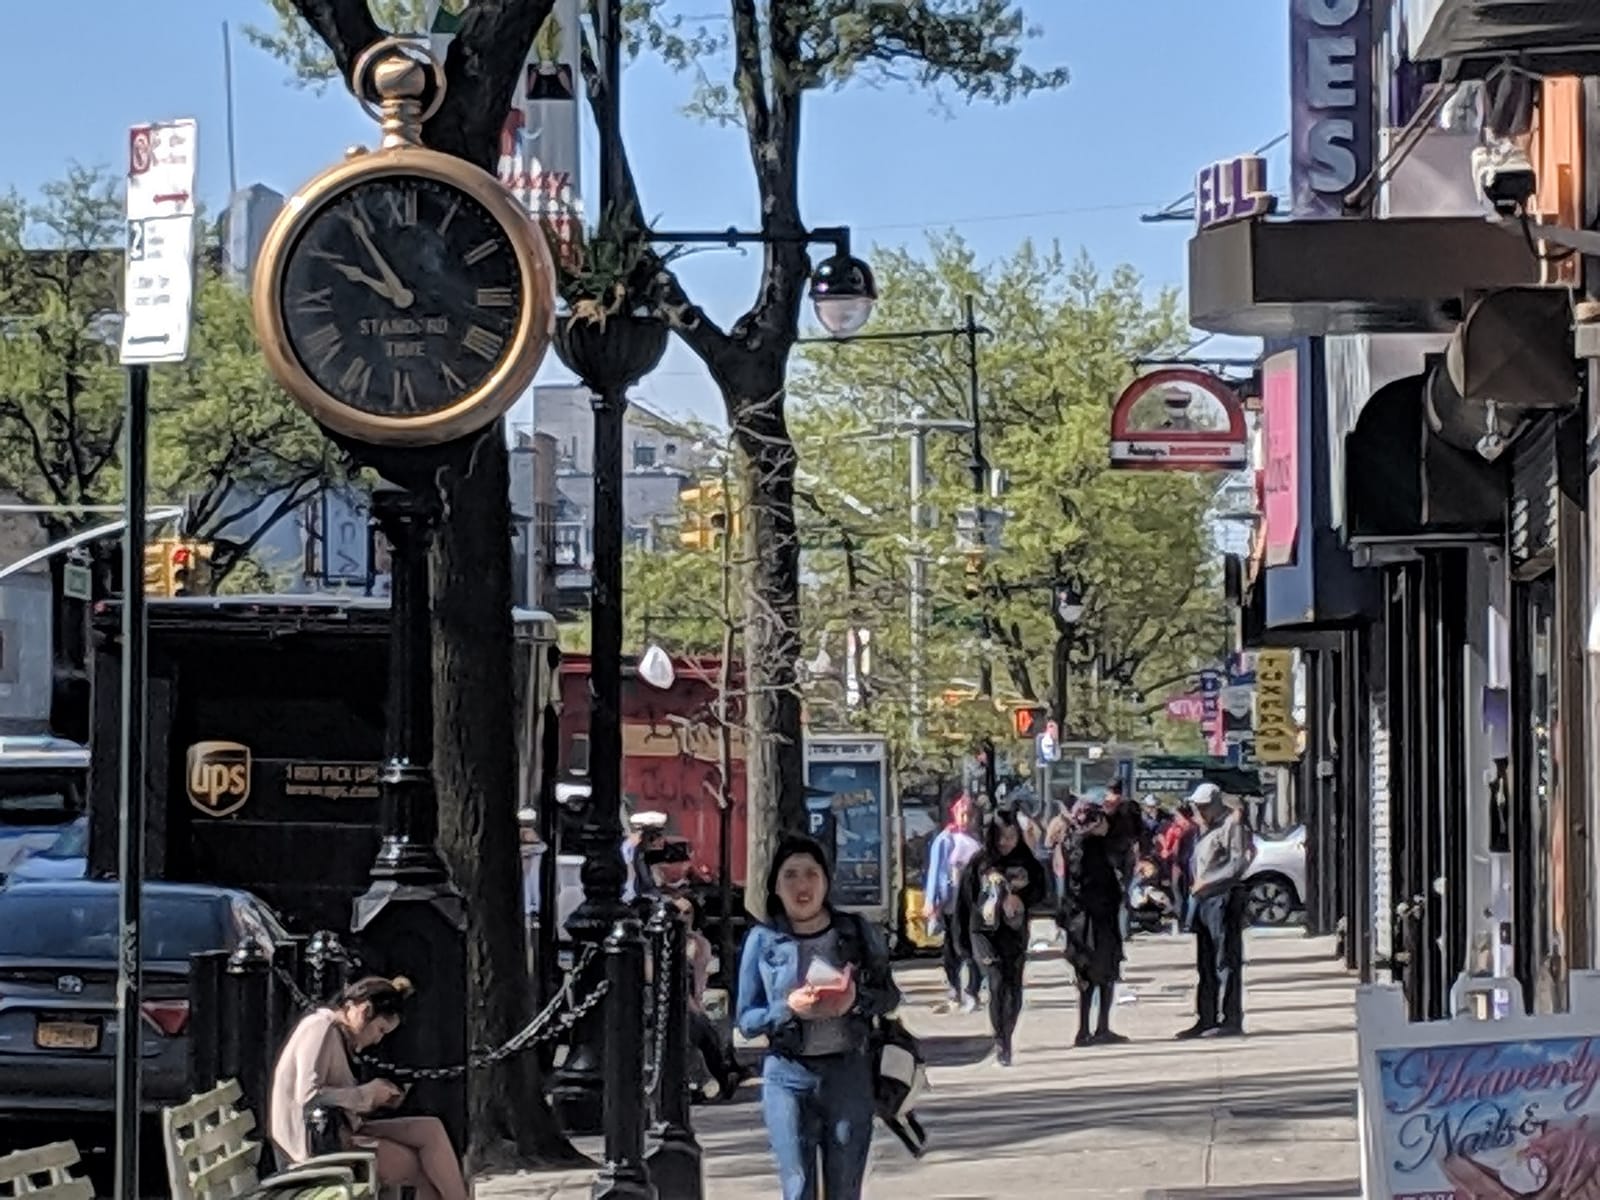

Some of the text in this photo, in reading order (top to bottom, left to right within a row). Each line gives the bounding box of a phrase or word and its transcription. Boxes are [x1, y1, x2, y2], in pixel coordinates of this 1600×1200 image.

[191, 763, 246, 806] ups
[1384, 1036, 1600, 1114] Heavenly
[1394, 1102, 1516, 1172] Nails
